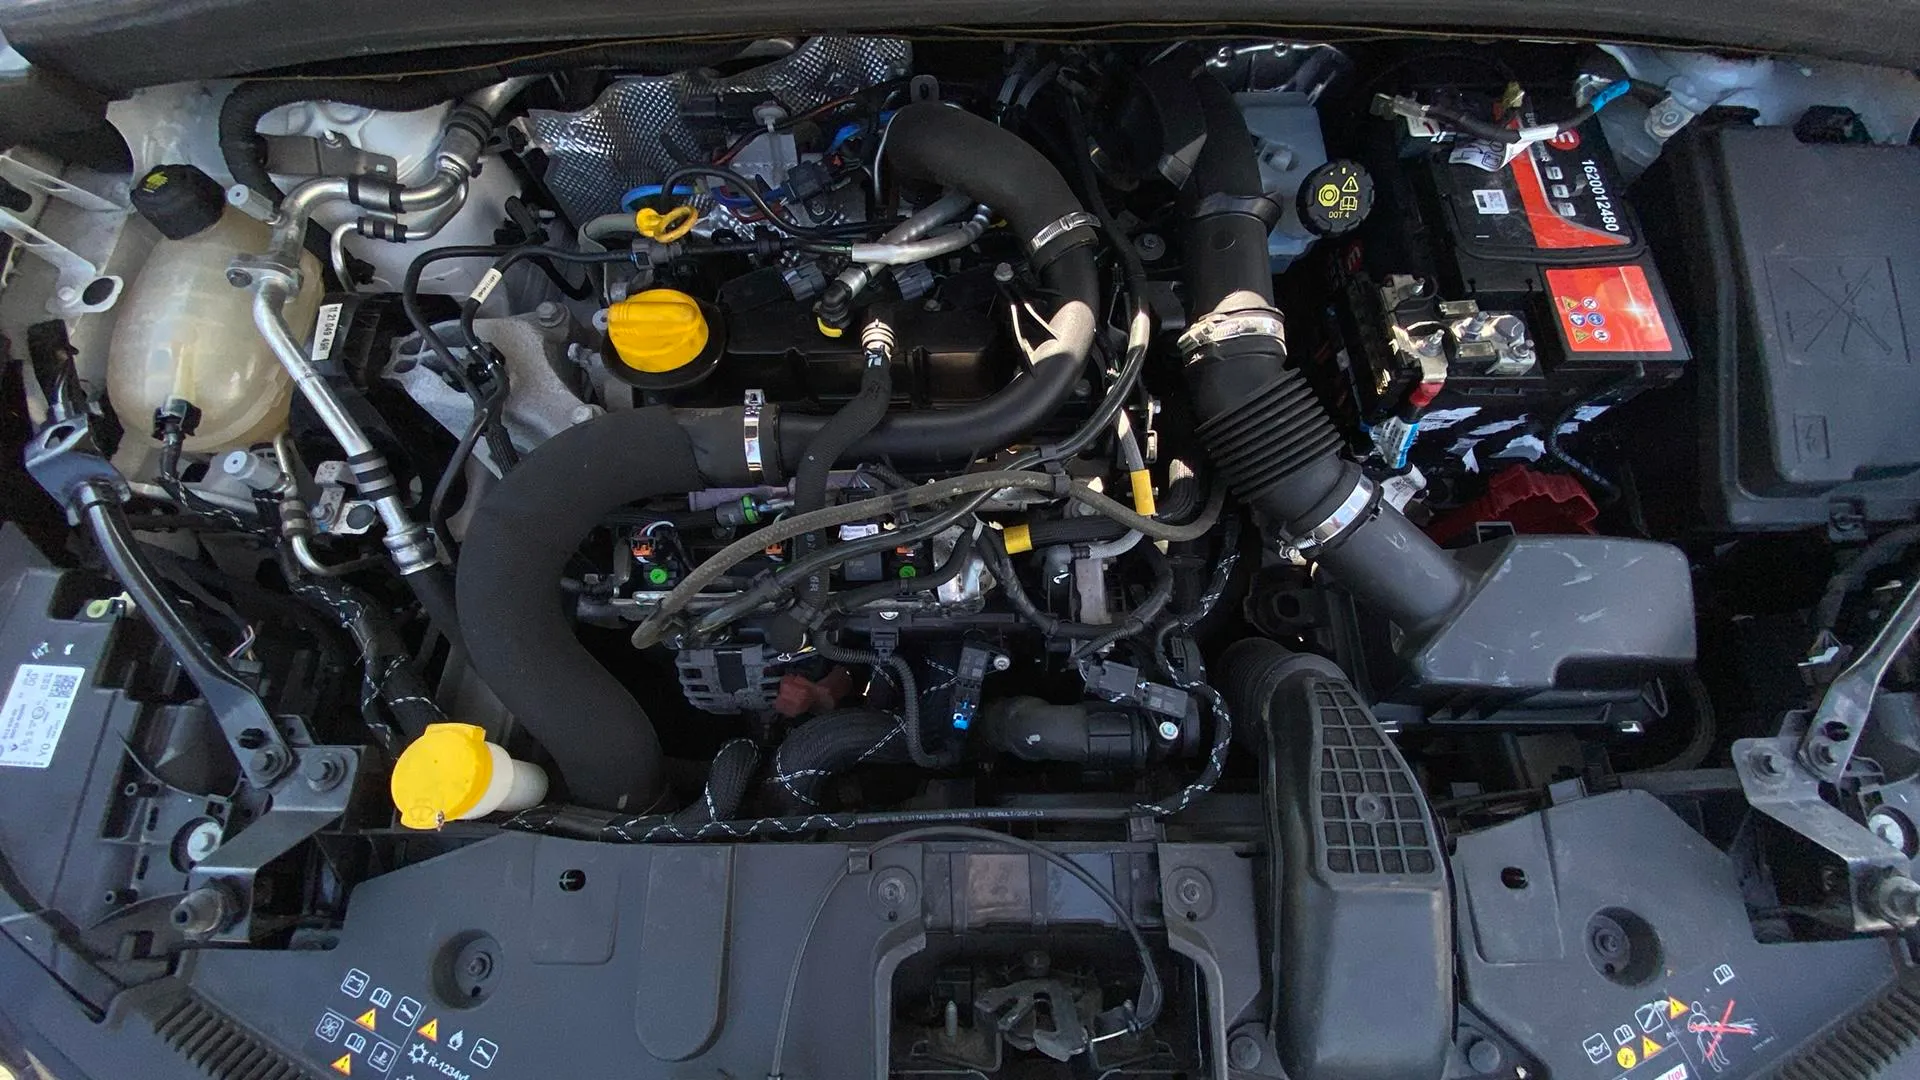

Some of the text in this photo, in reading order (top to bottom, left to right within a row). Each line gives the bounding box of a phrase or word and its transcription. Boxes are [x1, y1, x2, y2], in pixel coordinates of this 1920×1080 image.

[1328, 211, 1350, 219] DOT 4
[1582, 159, 1620, 232] 1620012480
